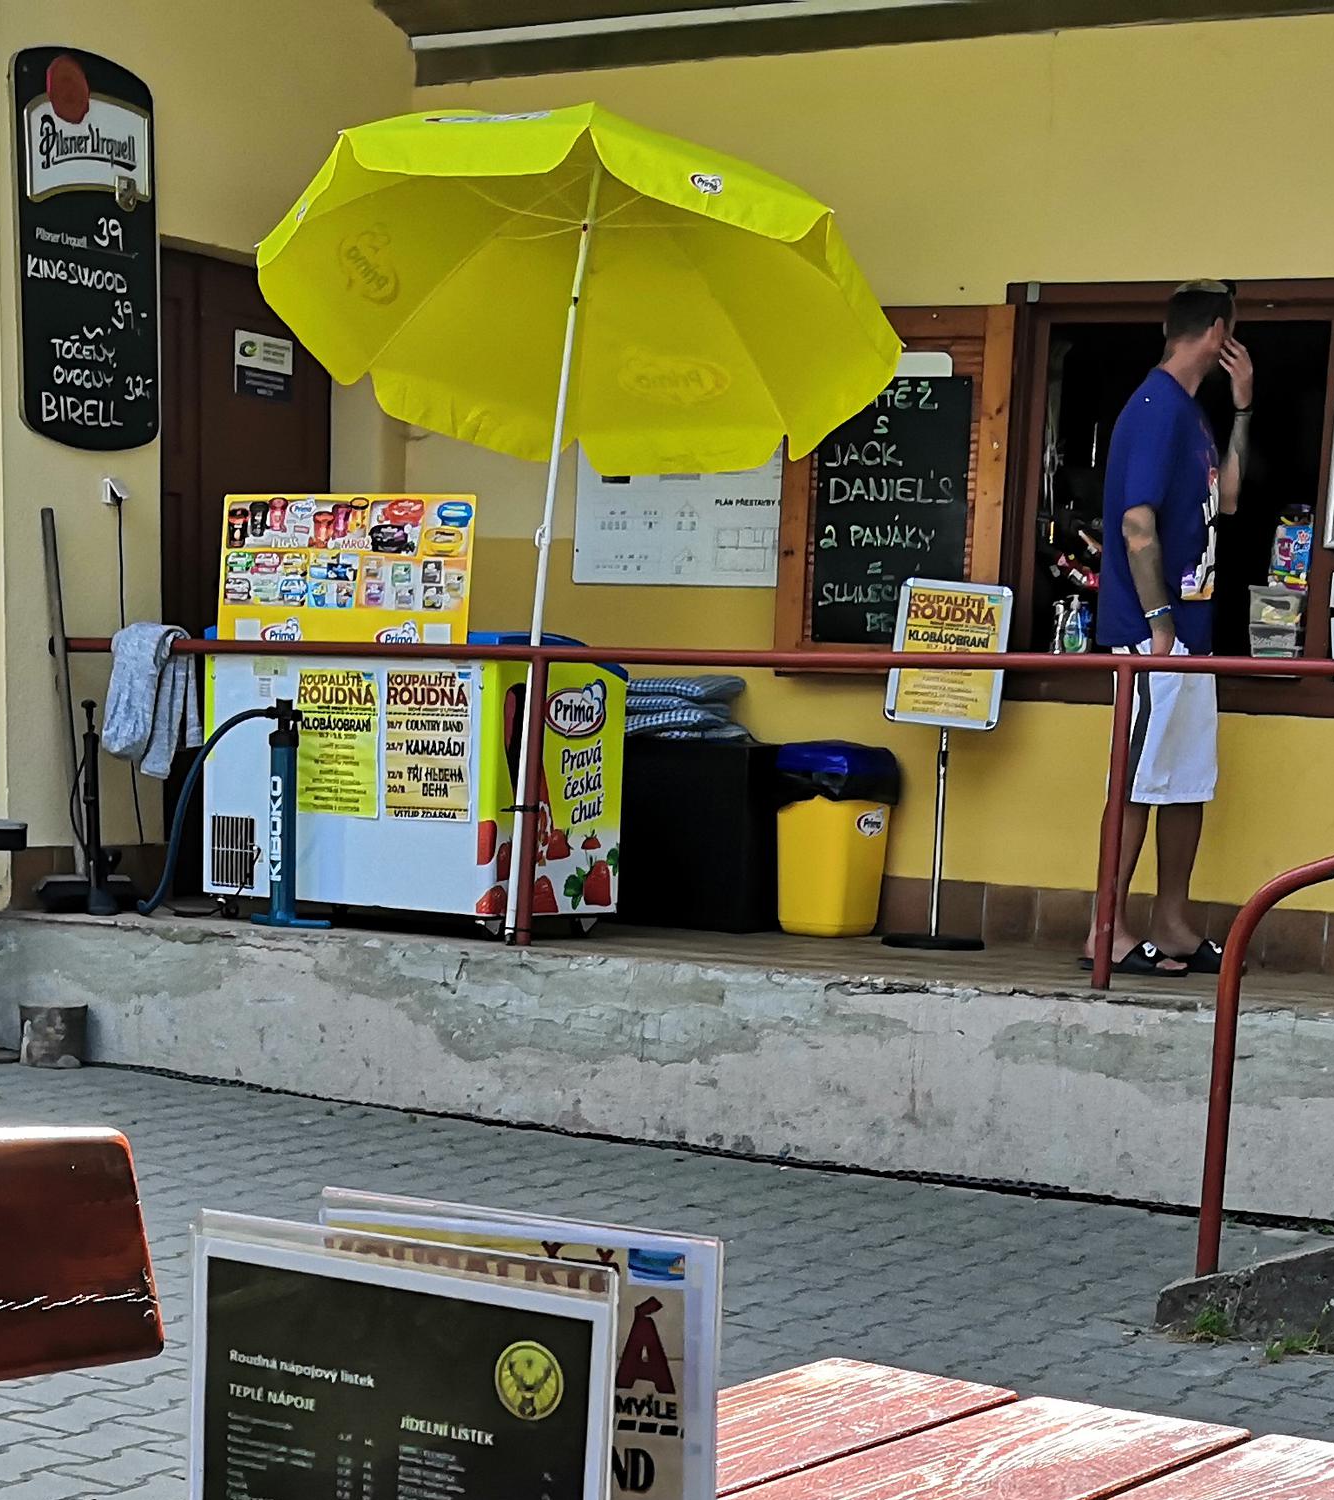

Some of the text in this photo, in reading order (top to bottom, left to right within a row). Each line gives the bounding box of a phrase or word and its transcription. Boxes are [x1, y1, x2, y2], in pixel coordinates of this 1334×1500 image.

[39, 114, 136, 169] Pilsner Urquell
[35, 217, 124, 251] Pilsner Urquell 39
[27, 253, 127, 294] KINGSWOOD
[41, 391, 124, 427] BIRELL
[873, 415, 889, 434] S
[825, 441, 903, 467] JACK
[829, 469, 954, 504] DANIEL'S
[715, 497, 775, 508] PLÁN PŘESTAVBY
[819, 514, 935, 551] 2 PANÁKY
[909, 590, 985, 610] KOUPALIŠTĚ
[908, 604, 996, 627] ROUDNÁ
[269, 629, 296, 642] Prima
[384, 633, 413, 645] Prima
[908, 629, 991, 649] KLOBÁSOBRANÍ
[299, 671, 363, 687] KOUPALIŠTĚ
[387, 672, 457, 688] KOUPALIŠTĚ
[298, 683, 376, 707] ROUDNÁ
[386, 684, 468, 707] ROUDNÁ
[554, 699, 594, 722] Prima
[301, 713, 372, 732] KLOBÁSOBRANÍ
[405, 719, 442, 732] COUNTRY
[442, 720, 464, 733] BAND
[405, 737, 465, 757] KAMARÁDI
[561, 739, 602, 775] Pravá
[563, 767, 602, 801] česká
[420, 810, 457, 821] ZDARMA
[571, 793, 604, 825] chuť
[270, 776, 283, 882] KIBOKO
[229, 1349, 277, 1370] Roudná
[279, 1359, 338, 1384] nápojový
[229, 1383, 315, 1412] TEPLÉ NÁPOJE
[400, 1415, 495, 1446] JÍDELNÍ LÍSTEK
